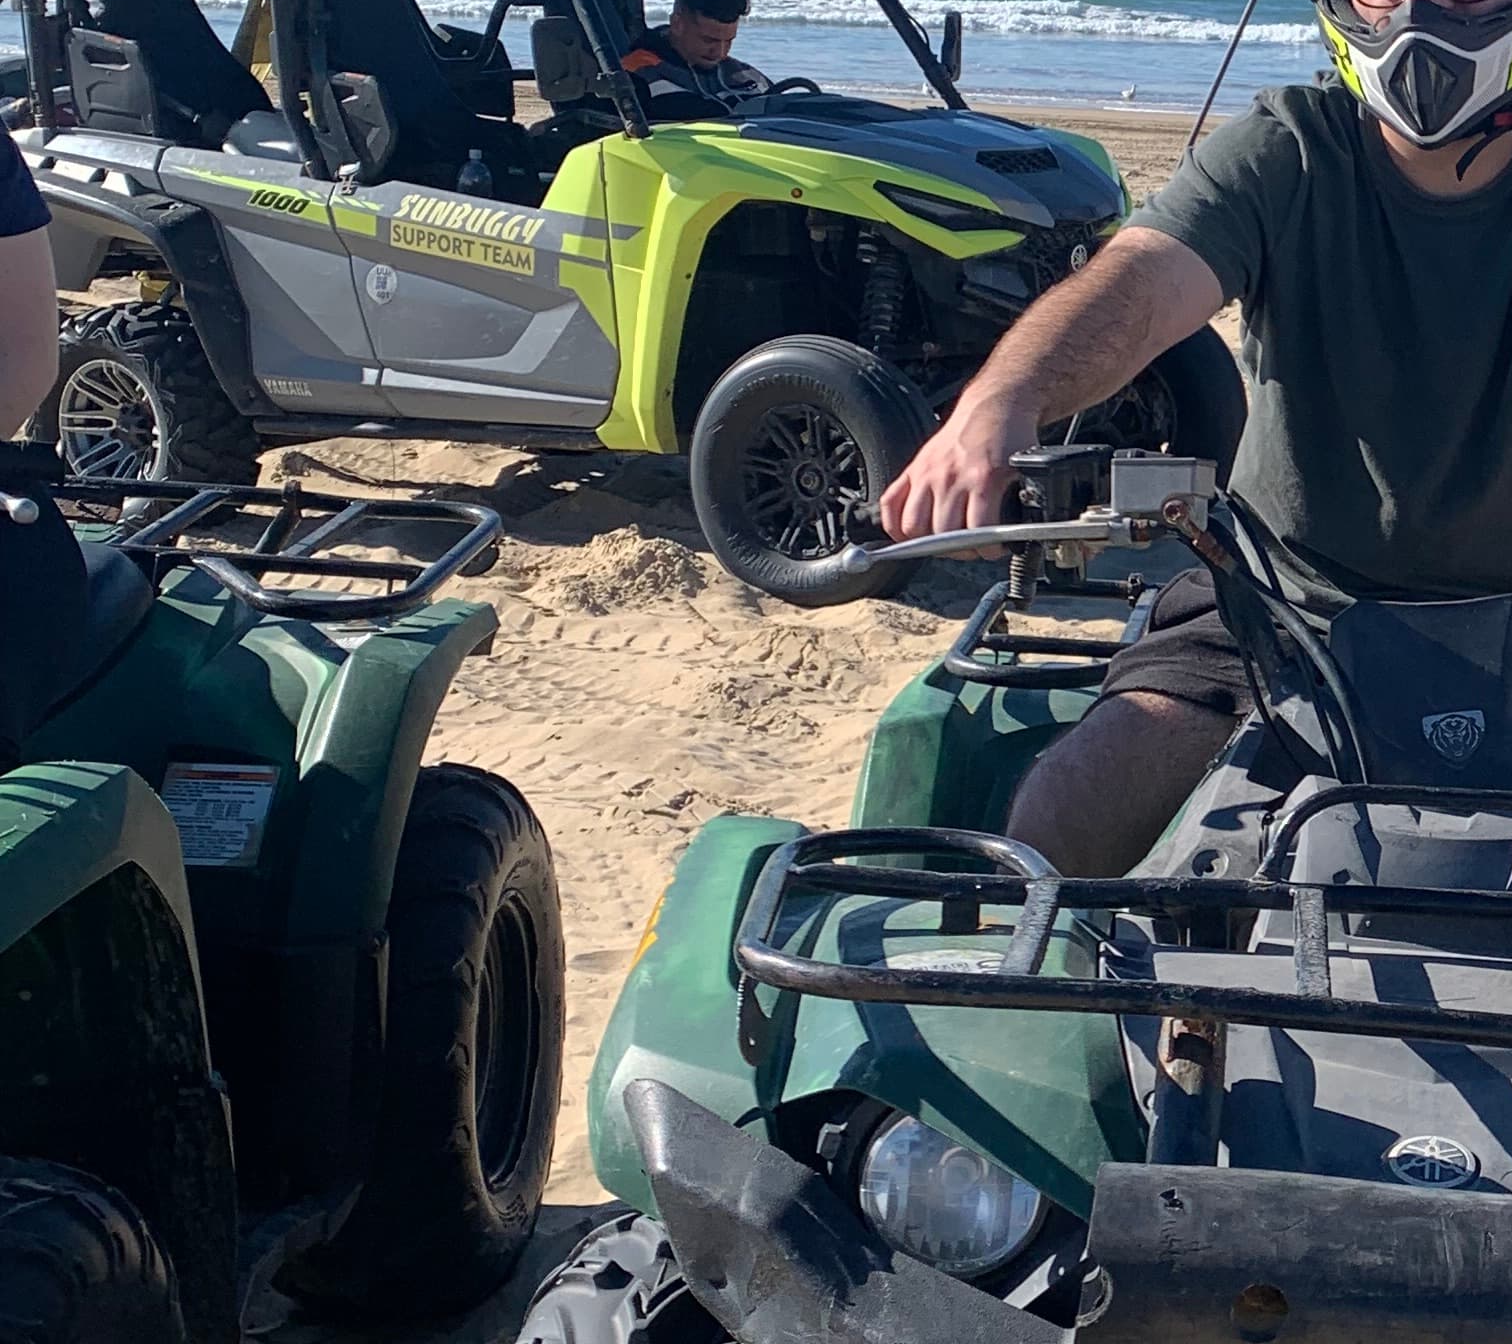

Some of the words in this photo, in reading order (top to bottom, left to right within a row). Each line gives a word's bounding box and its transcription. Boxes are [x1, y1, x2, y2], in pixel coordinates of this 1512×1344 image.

[247, 189, 312, 216] 1000
[393, 194, 545, 244] SUNBUGGY
[392, 224, 475, 258] SUPPORT
[480, 242, 532, 271] TEAM
